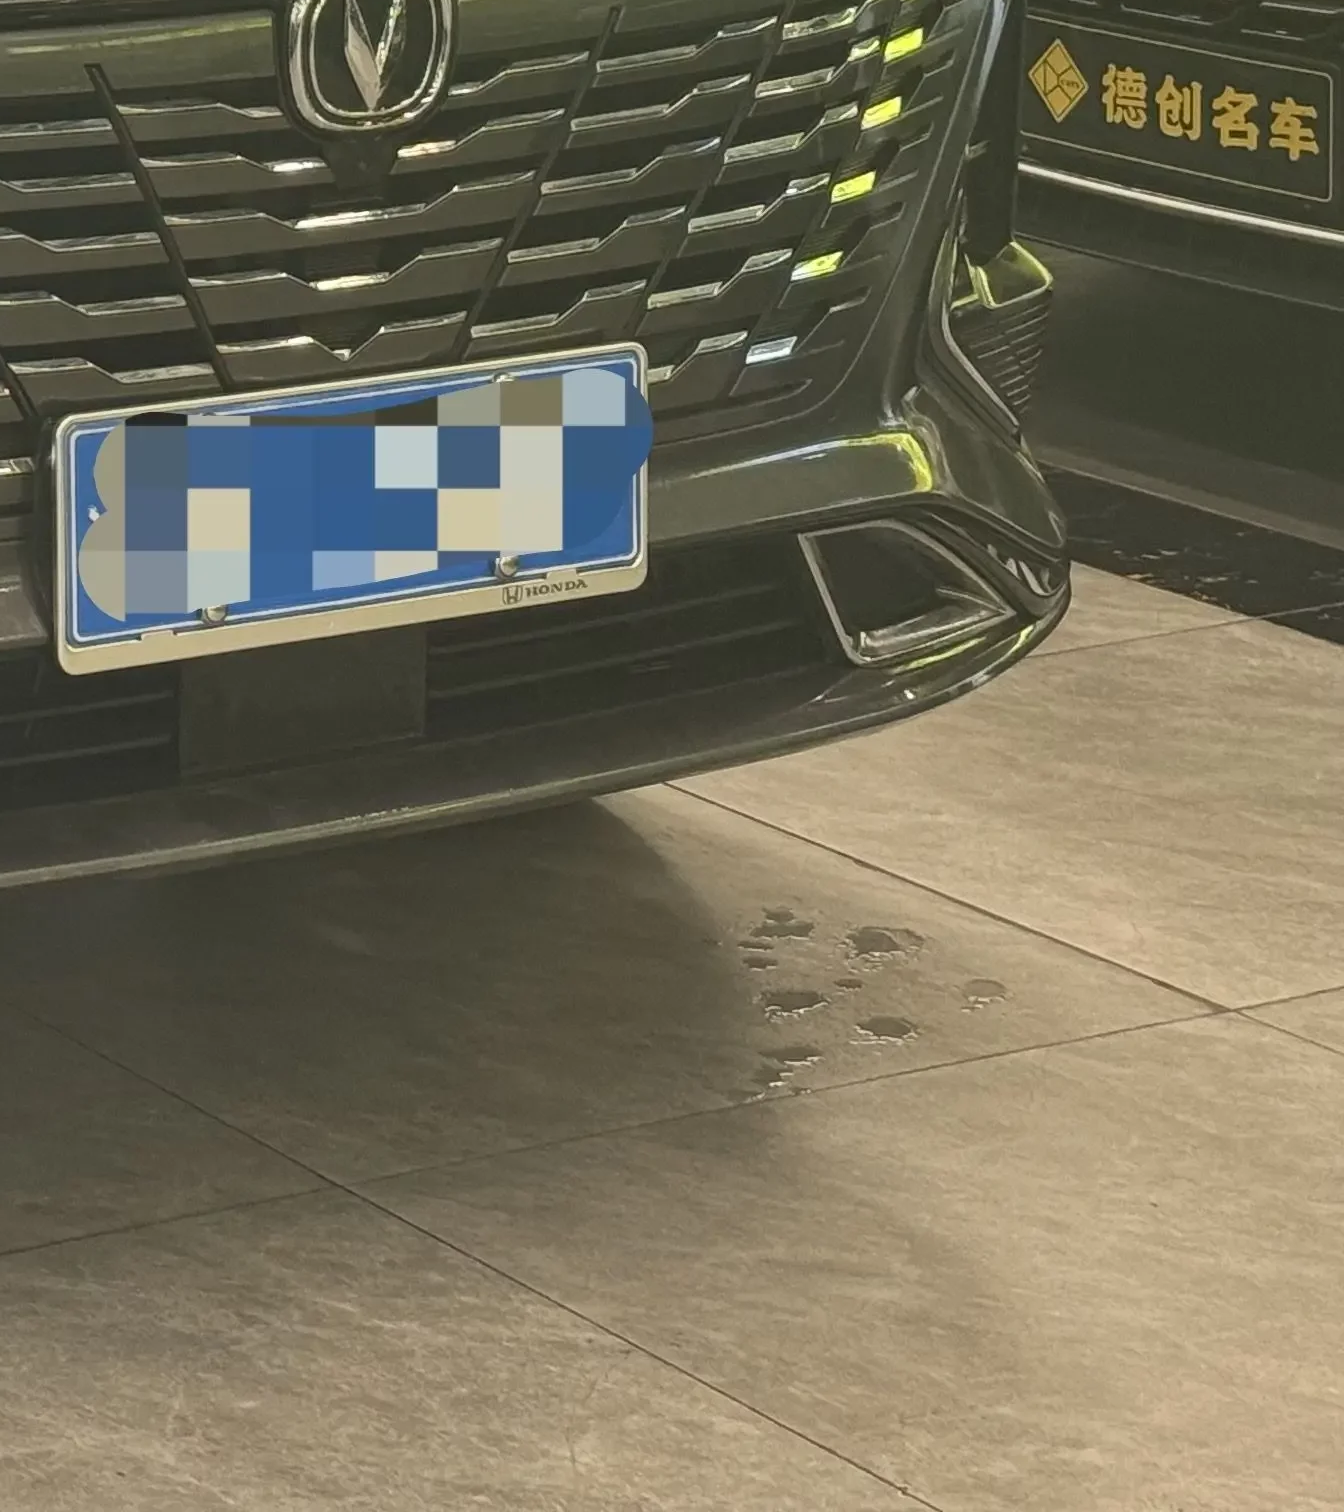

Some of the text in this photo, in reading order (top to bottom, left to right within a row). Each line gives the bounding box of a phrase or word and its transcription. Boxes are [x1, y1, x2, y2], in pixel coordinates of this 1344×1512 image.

[1101, 63, 1320, 162] 德创名车
[525, 578, 588, 598] HONDA
